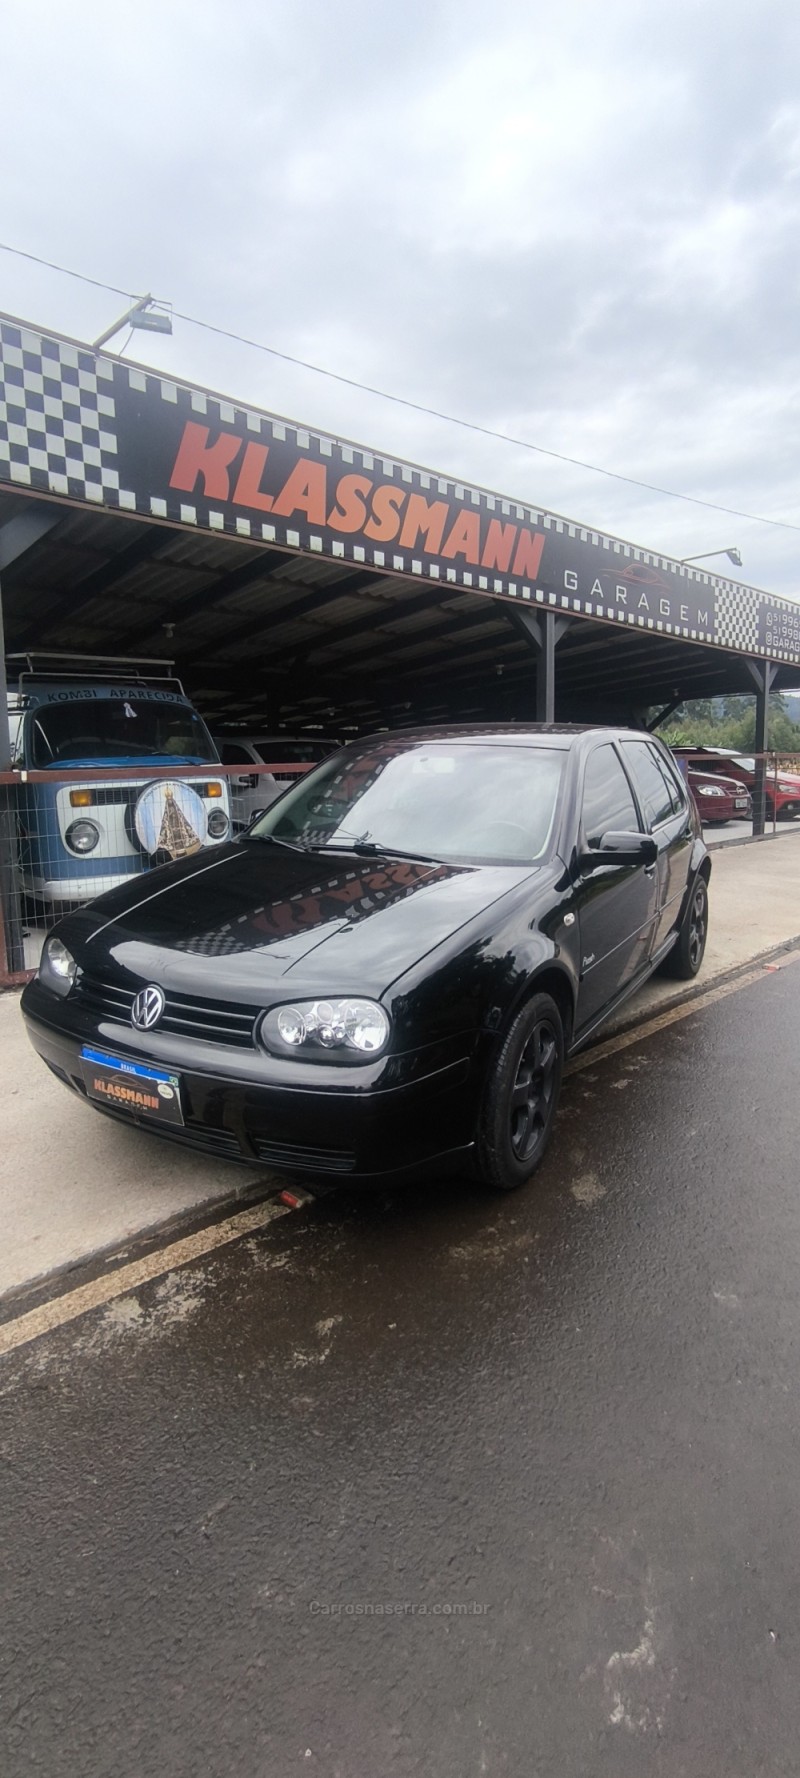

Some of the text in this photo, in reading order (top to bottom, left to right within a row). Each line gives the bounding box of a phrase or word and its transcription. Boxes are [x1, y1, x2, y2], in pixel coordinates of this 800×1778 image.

[169, 421, 546, 580] KLASSMANN
[564, 570, 709, 627] GARAGEM
[47, 689, 183, 703] KOMBI APARECIDA
[94, 1078, 159, 1110] KLASSMANN
